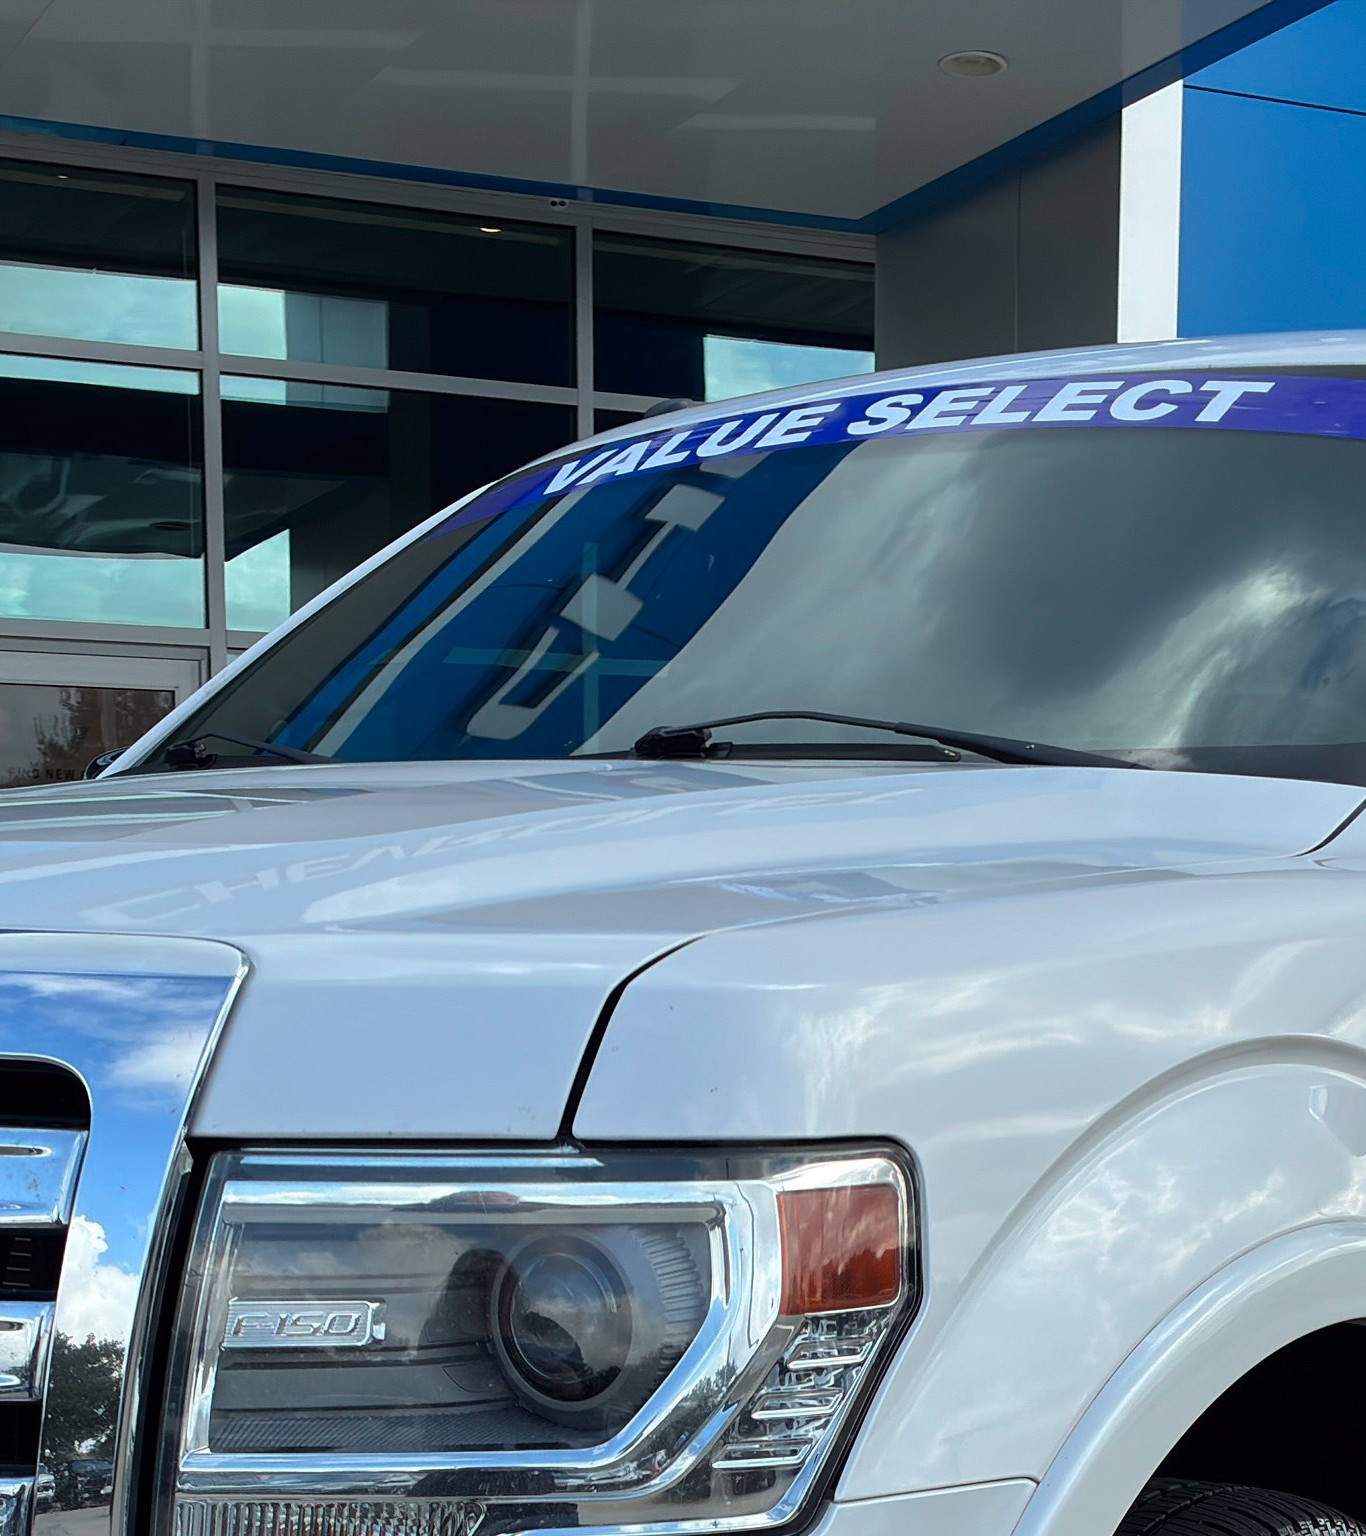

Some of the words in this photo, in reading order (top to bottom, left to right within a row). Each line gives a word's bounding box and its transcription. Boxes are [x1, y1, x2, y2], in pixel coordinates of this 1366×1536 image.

[543, 402, 841, 496] VALUE
[846, 379, 1276, 436] SELECT
[46, 768, 75, 780] NEW
